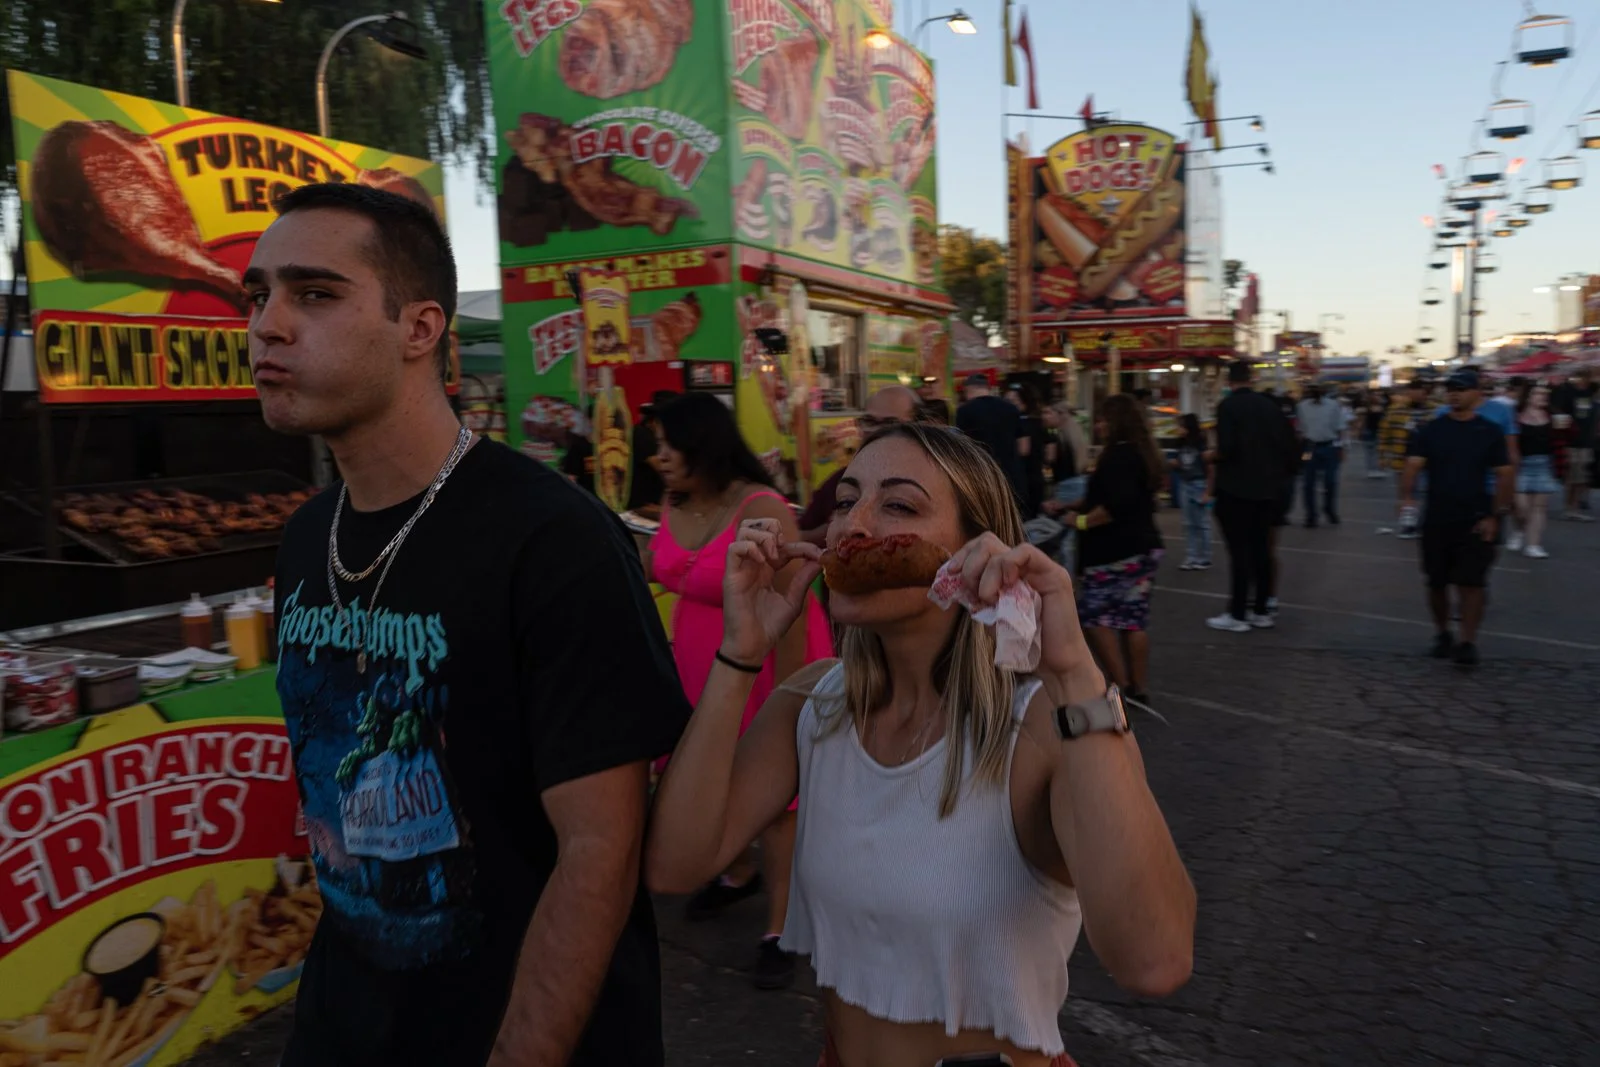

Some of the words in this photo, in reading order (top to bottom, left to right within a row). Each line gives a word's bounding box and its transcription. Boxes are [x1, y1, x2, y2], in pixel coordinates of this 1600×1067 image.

[175, 132, 349, 184] TURKEY
[572, 123, 709, 189] BACON
[1073, 133, 1148, 165] HOT
[37, 321, 160, 390] GIANT
[103, 731, 291, 800] RANCH
[0, 778, 249, 942] FRIES
